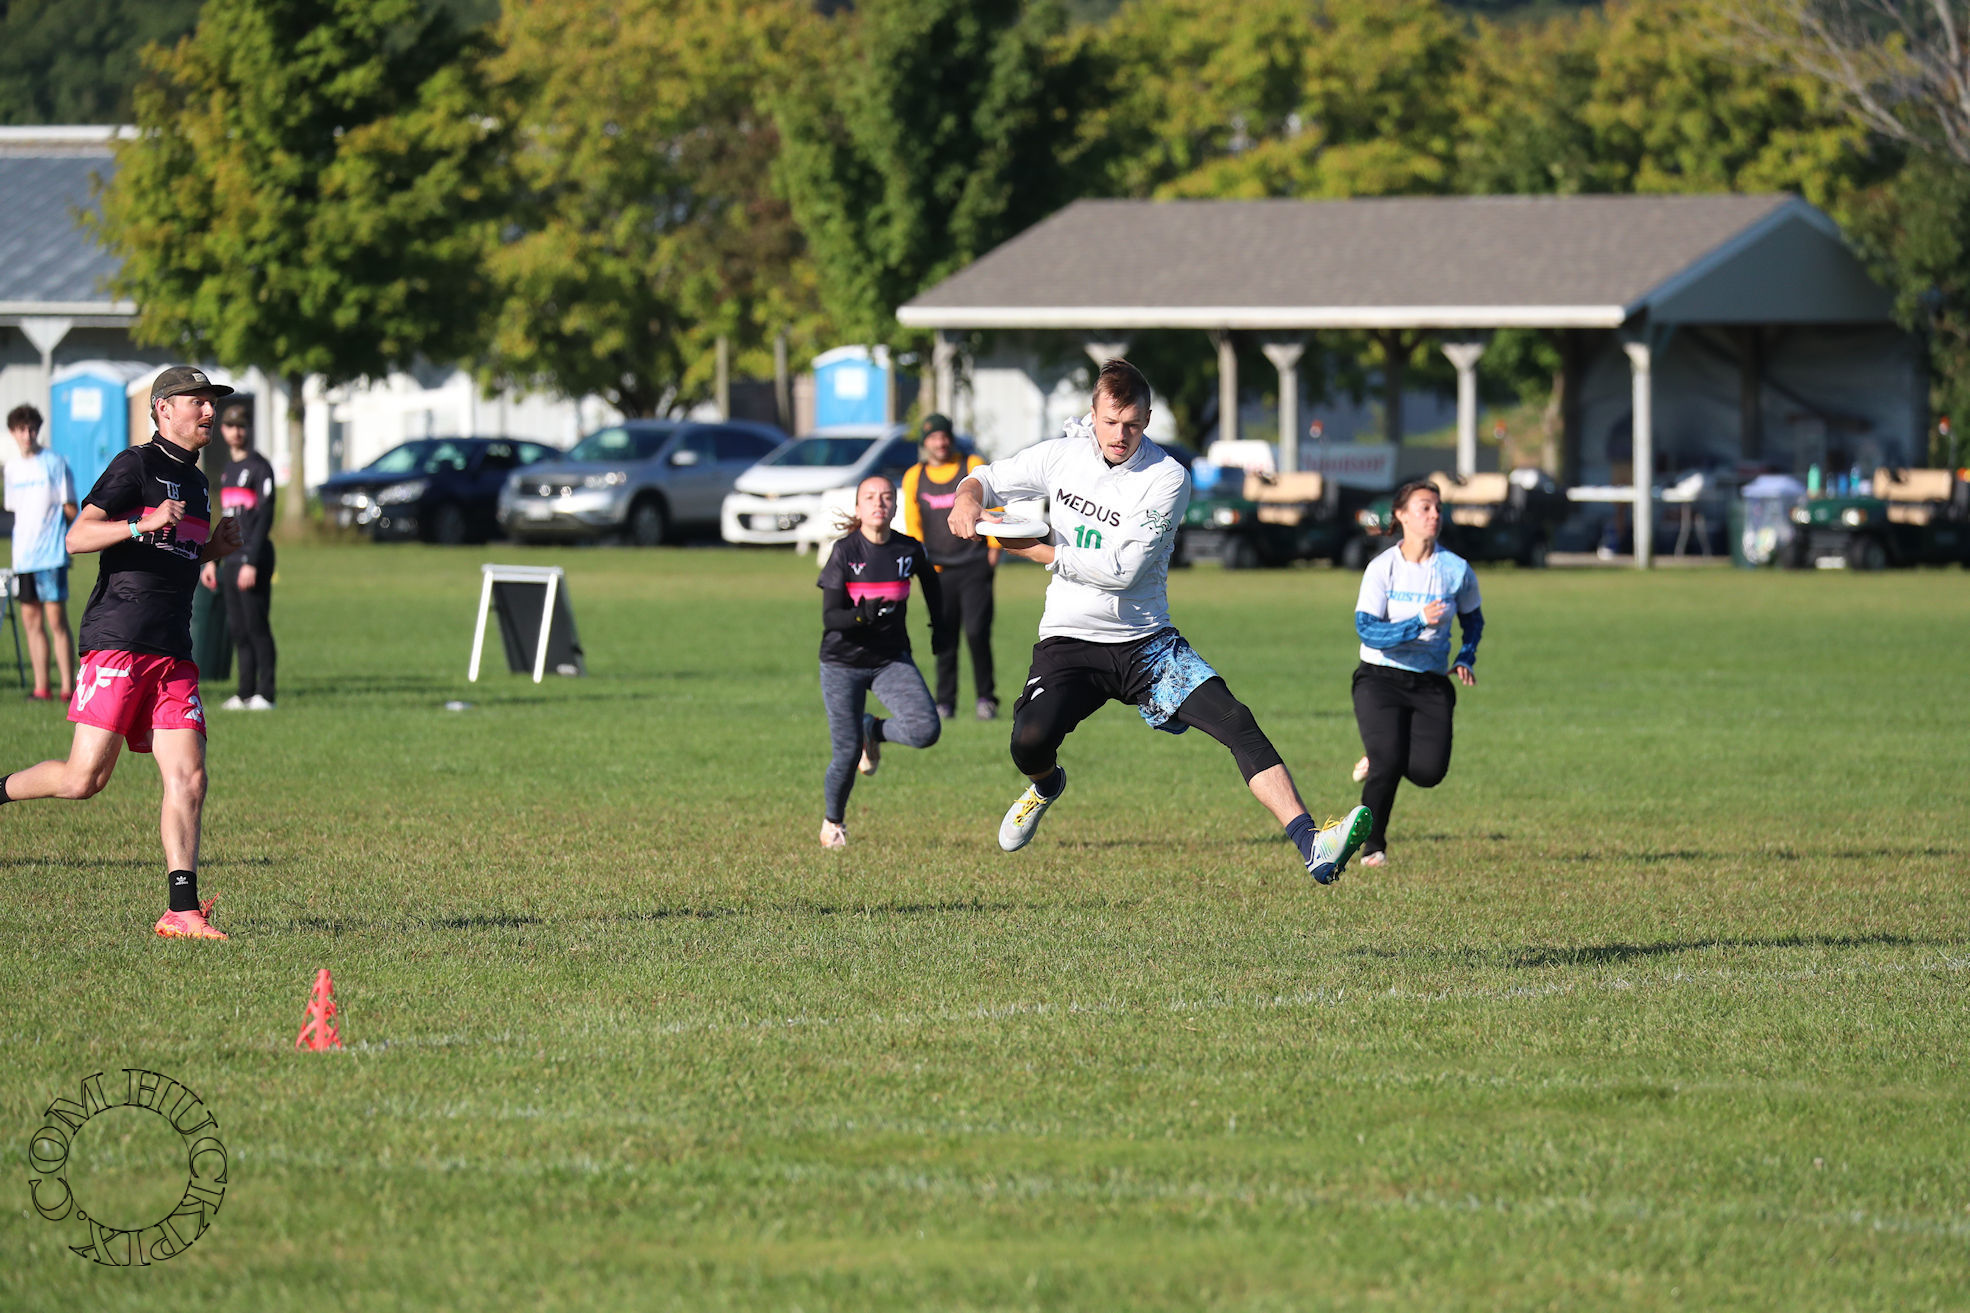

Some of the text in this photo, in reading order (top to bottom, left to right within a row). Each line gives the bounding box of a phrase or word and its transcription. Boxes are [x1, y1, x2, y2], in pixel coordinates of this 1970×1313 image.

[1056, 488, 1121, 527] MEDUS
[1074, 524, 1102, 550] 10
[896, 556, 913, 577] 12
